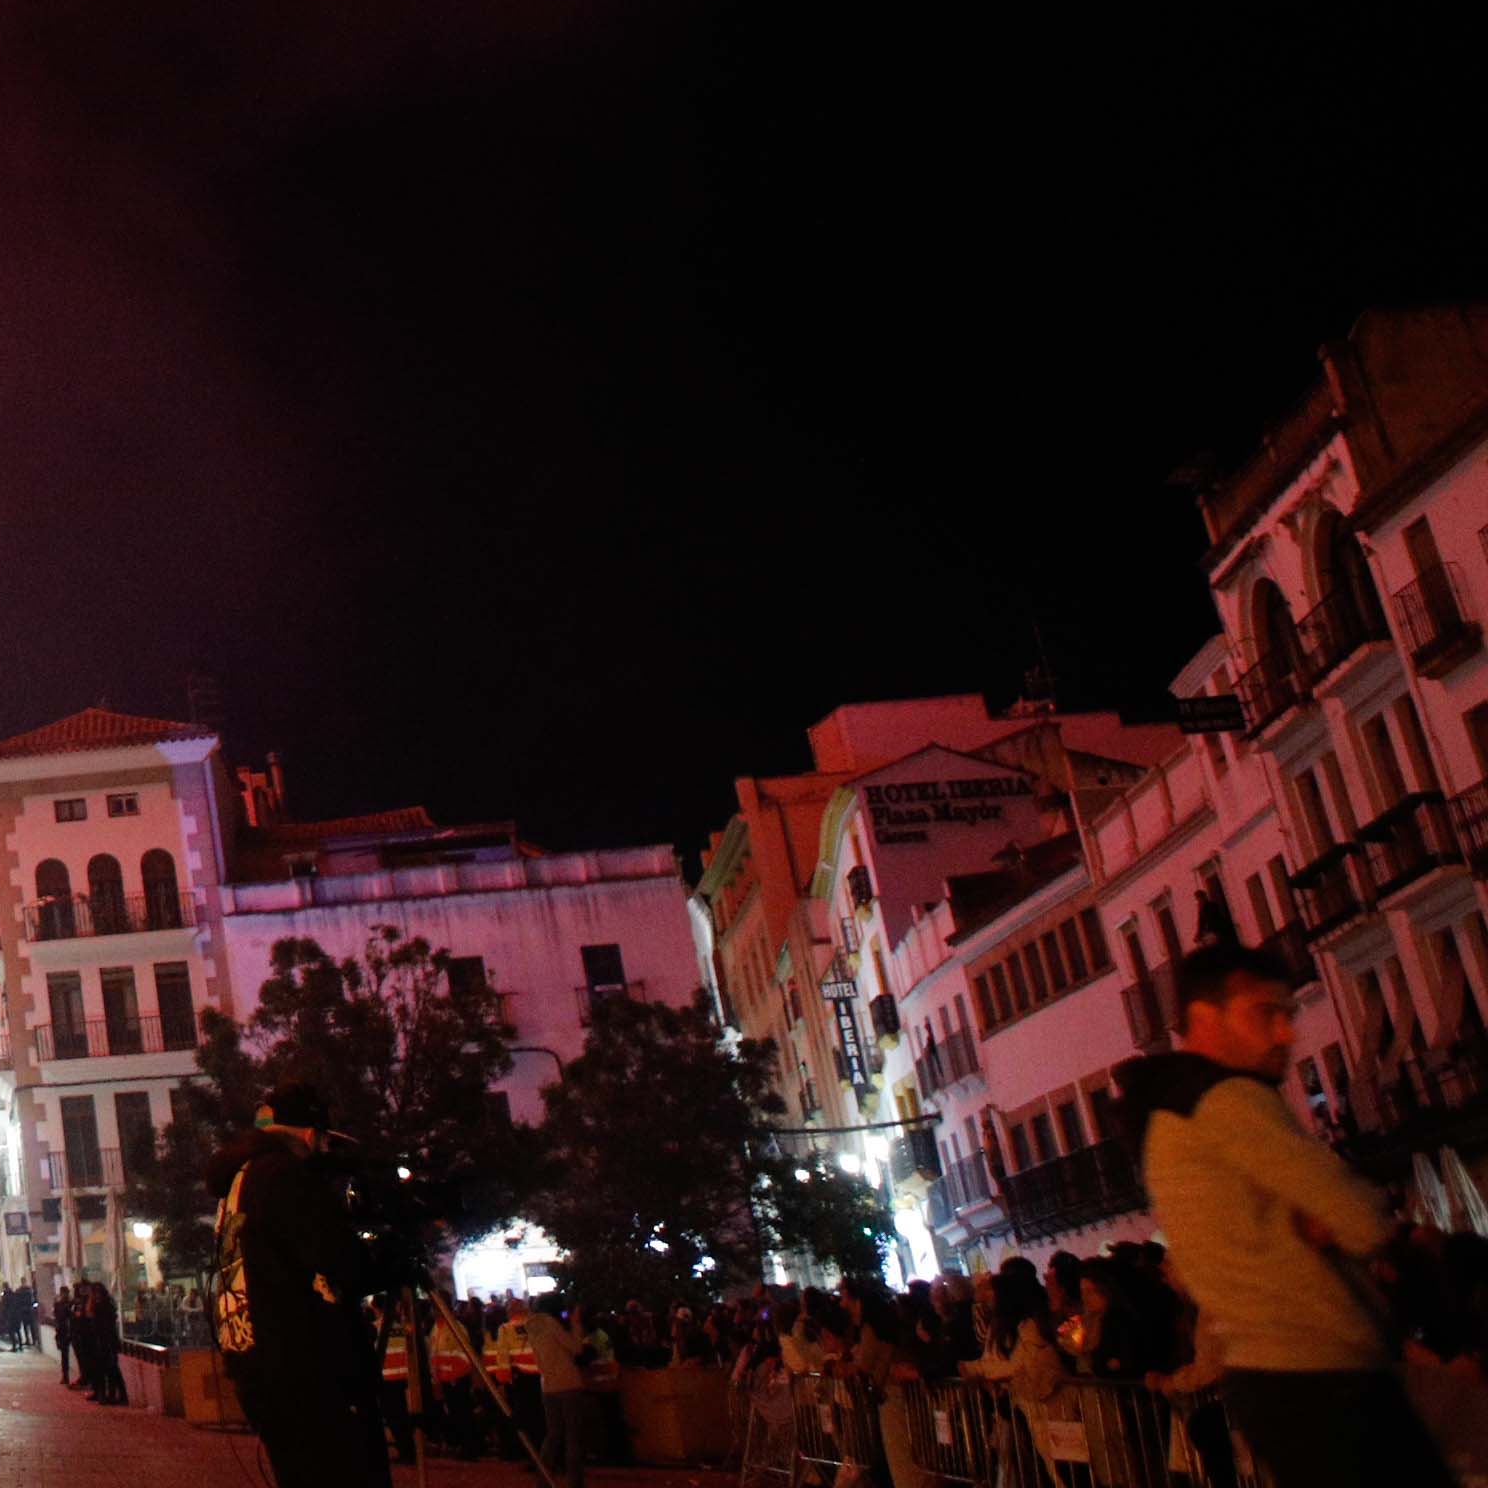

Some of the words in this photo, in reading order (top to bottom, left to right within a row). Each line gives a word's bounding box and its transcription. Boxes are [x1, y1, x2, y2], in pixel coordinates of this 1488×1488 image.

[865, 781, 947, 804] HOTEL
[948, 776, 1033, 800] IBERIA
[870, 806, 930, 826] Plaza
[822, 982, 857, 998] HOTEL
[838, 1001, 865, 1085] IBERIA
